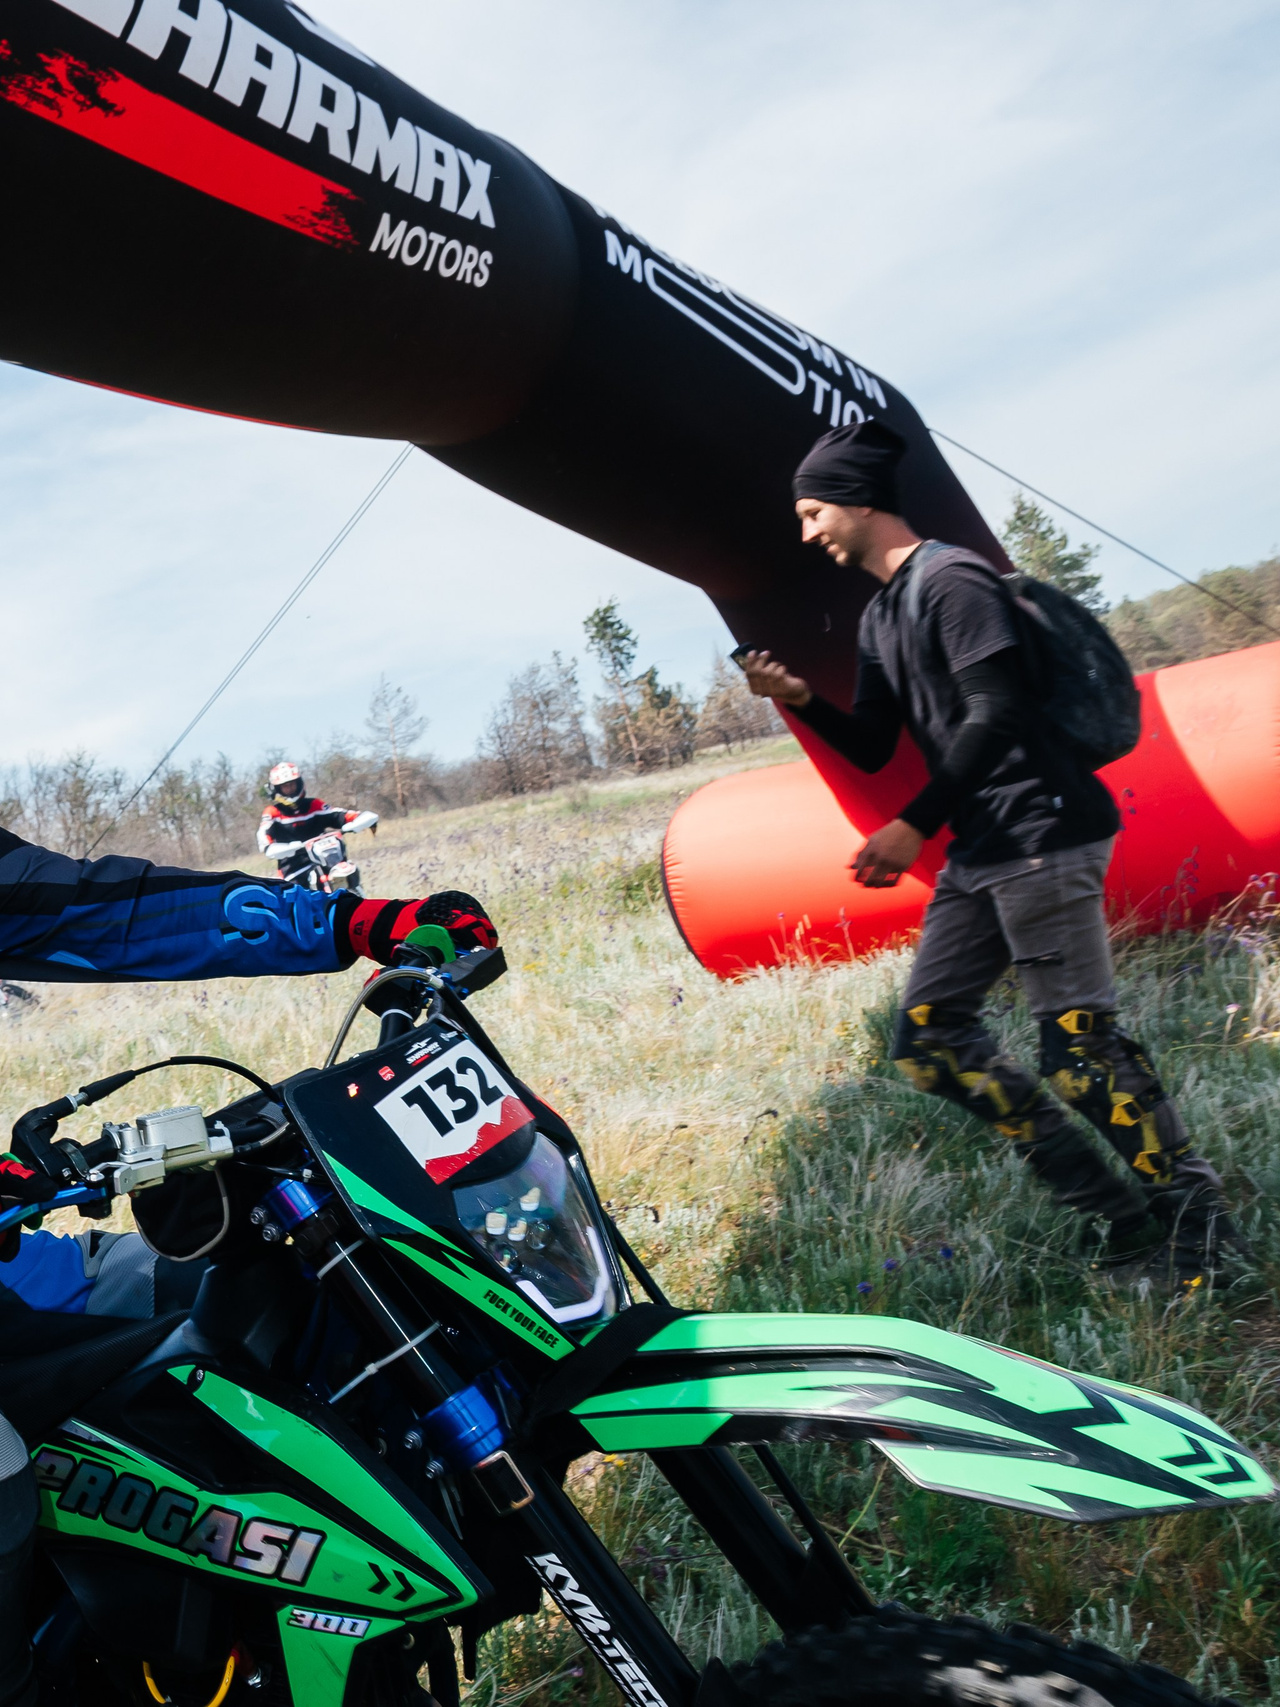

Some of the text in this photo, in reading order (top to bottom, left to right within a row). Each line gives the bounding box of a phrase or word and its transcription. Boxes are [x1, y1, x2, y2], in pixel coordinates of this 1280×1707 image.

[369, 212, 494, 288] MOTORS
[605, 229, 873, 428] MOTIO
[401, 1056, 505, 1137] 132
[483, 1289, 560, 1349] FUCK YOUR FACE
[33, 1447, 326, 1587] PROGASI
[287, 1607, 372, 1639] 300
